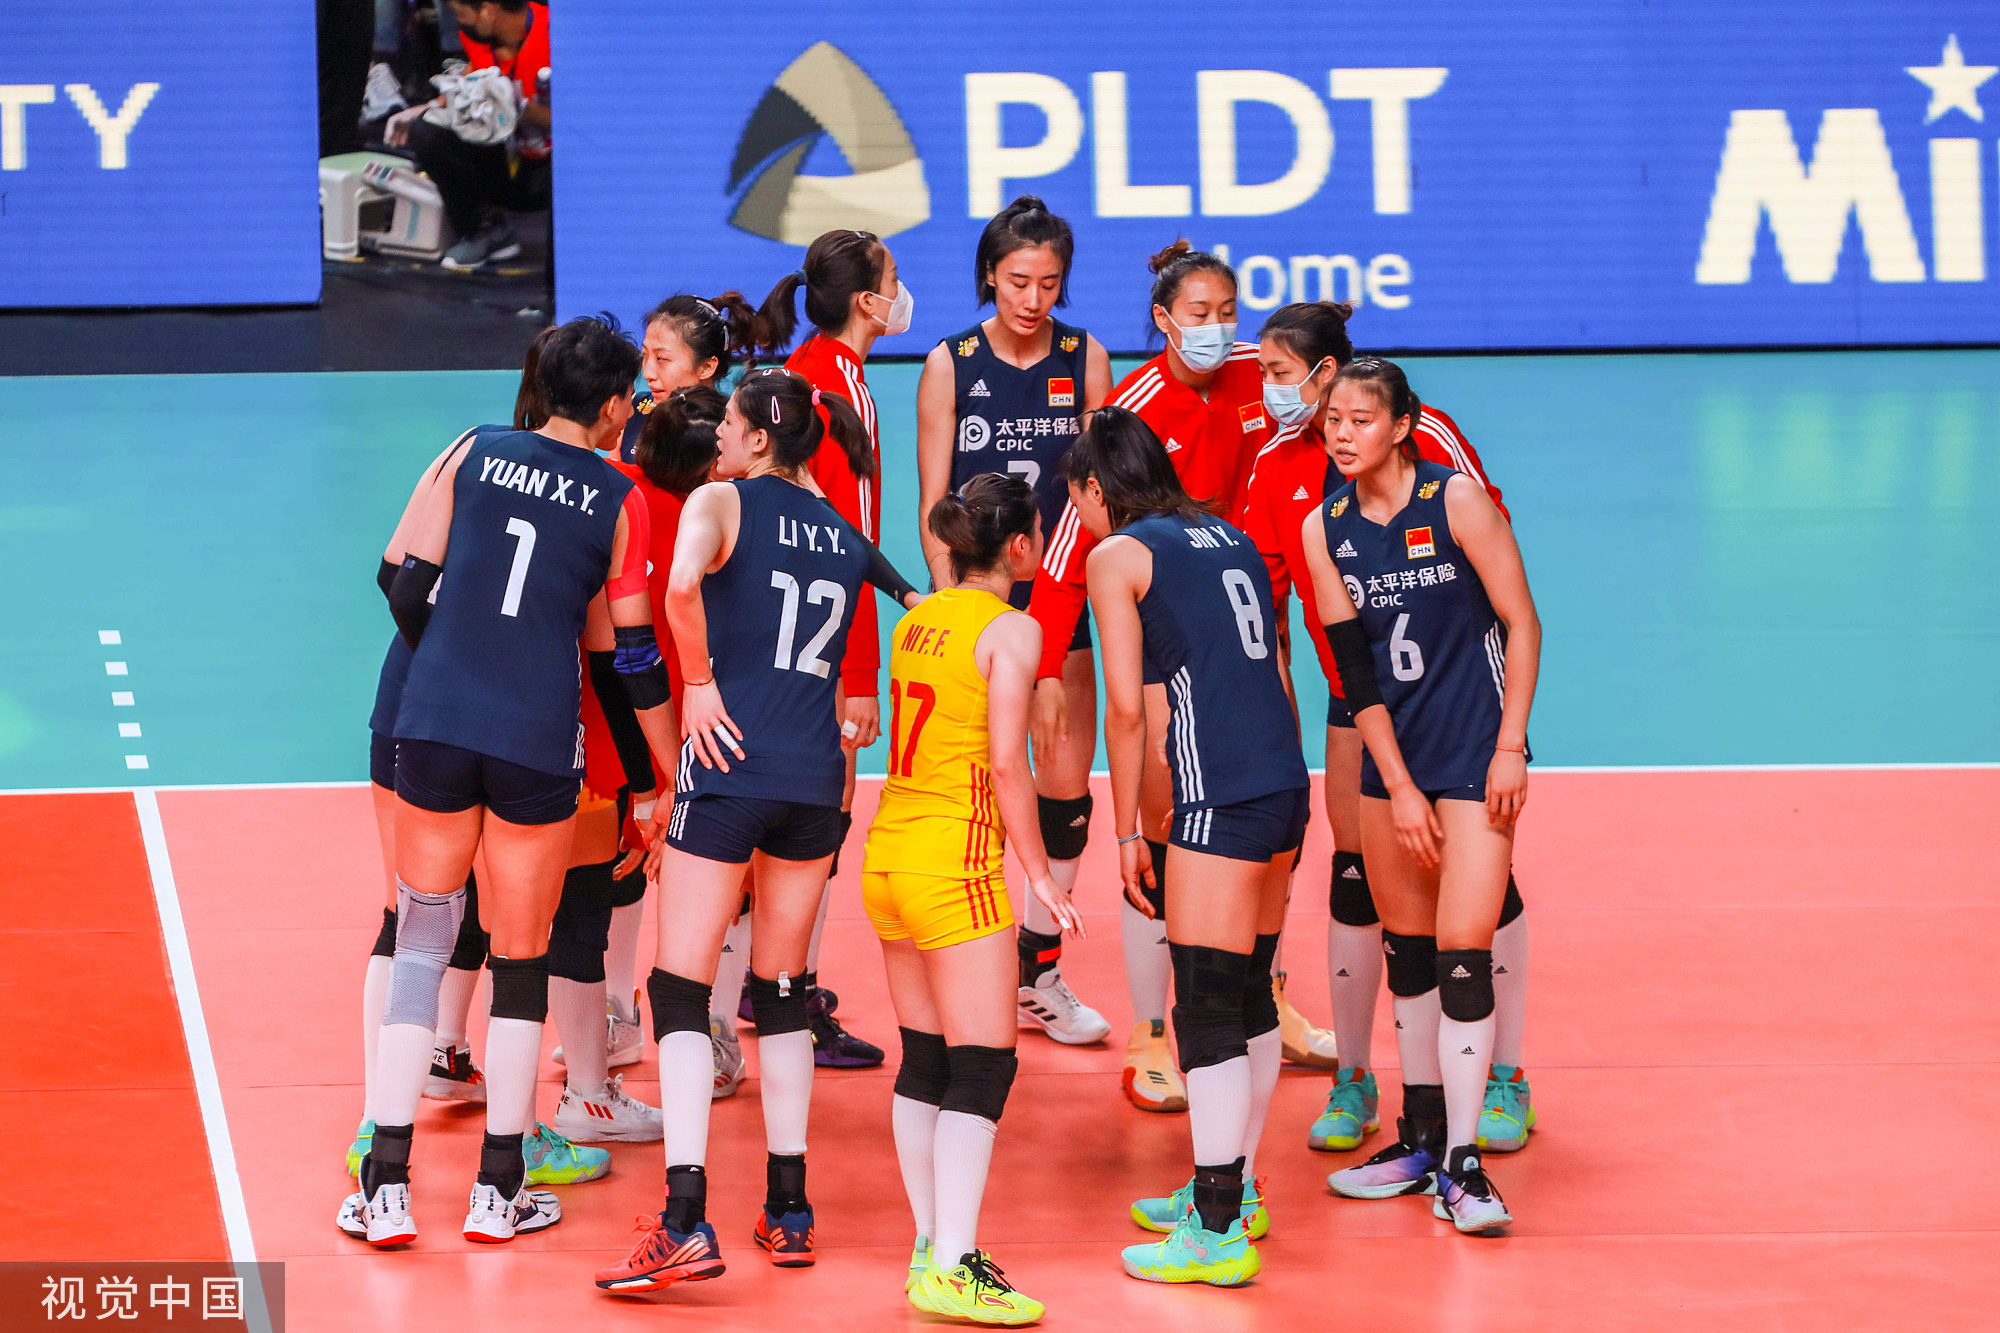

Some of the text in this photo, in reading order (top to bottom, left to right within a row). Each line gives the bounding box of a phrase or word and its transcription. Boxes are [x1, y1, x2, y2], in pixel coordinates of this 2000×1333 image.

[0, 82, 161, 171] TY
[964, 67, 1449, 218] PLDT
[1694, 34, 2000, 284] Mi
[1212, 243, 1412, 310] ome
[1051, 396, 1072, 404] CHN
[996, 438, 1033, 451] CPIC
[1244, 419, 1263, 431] CHN
[479, 456, 550, 498] YUAN
[778, 515, 798, 548] LI
[1184, 525, 1240, 549] JIN Y.
[1411, 546, 1432, 556] CHN
[501, 516, 537, 618] 1
[1366, 562, 1458, 595] 太平洋保险
[1222, 568, 1268, 660] 8
[1370, 593, 1404, 609] CPIC
[770, 569, 847, 680] 12
[900, 623, 925, 652] NI
[1389, 612, 1426, 682] 6
[889, 677, 937, 778] 17
